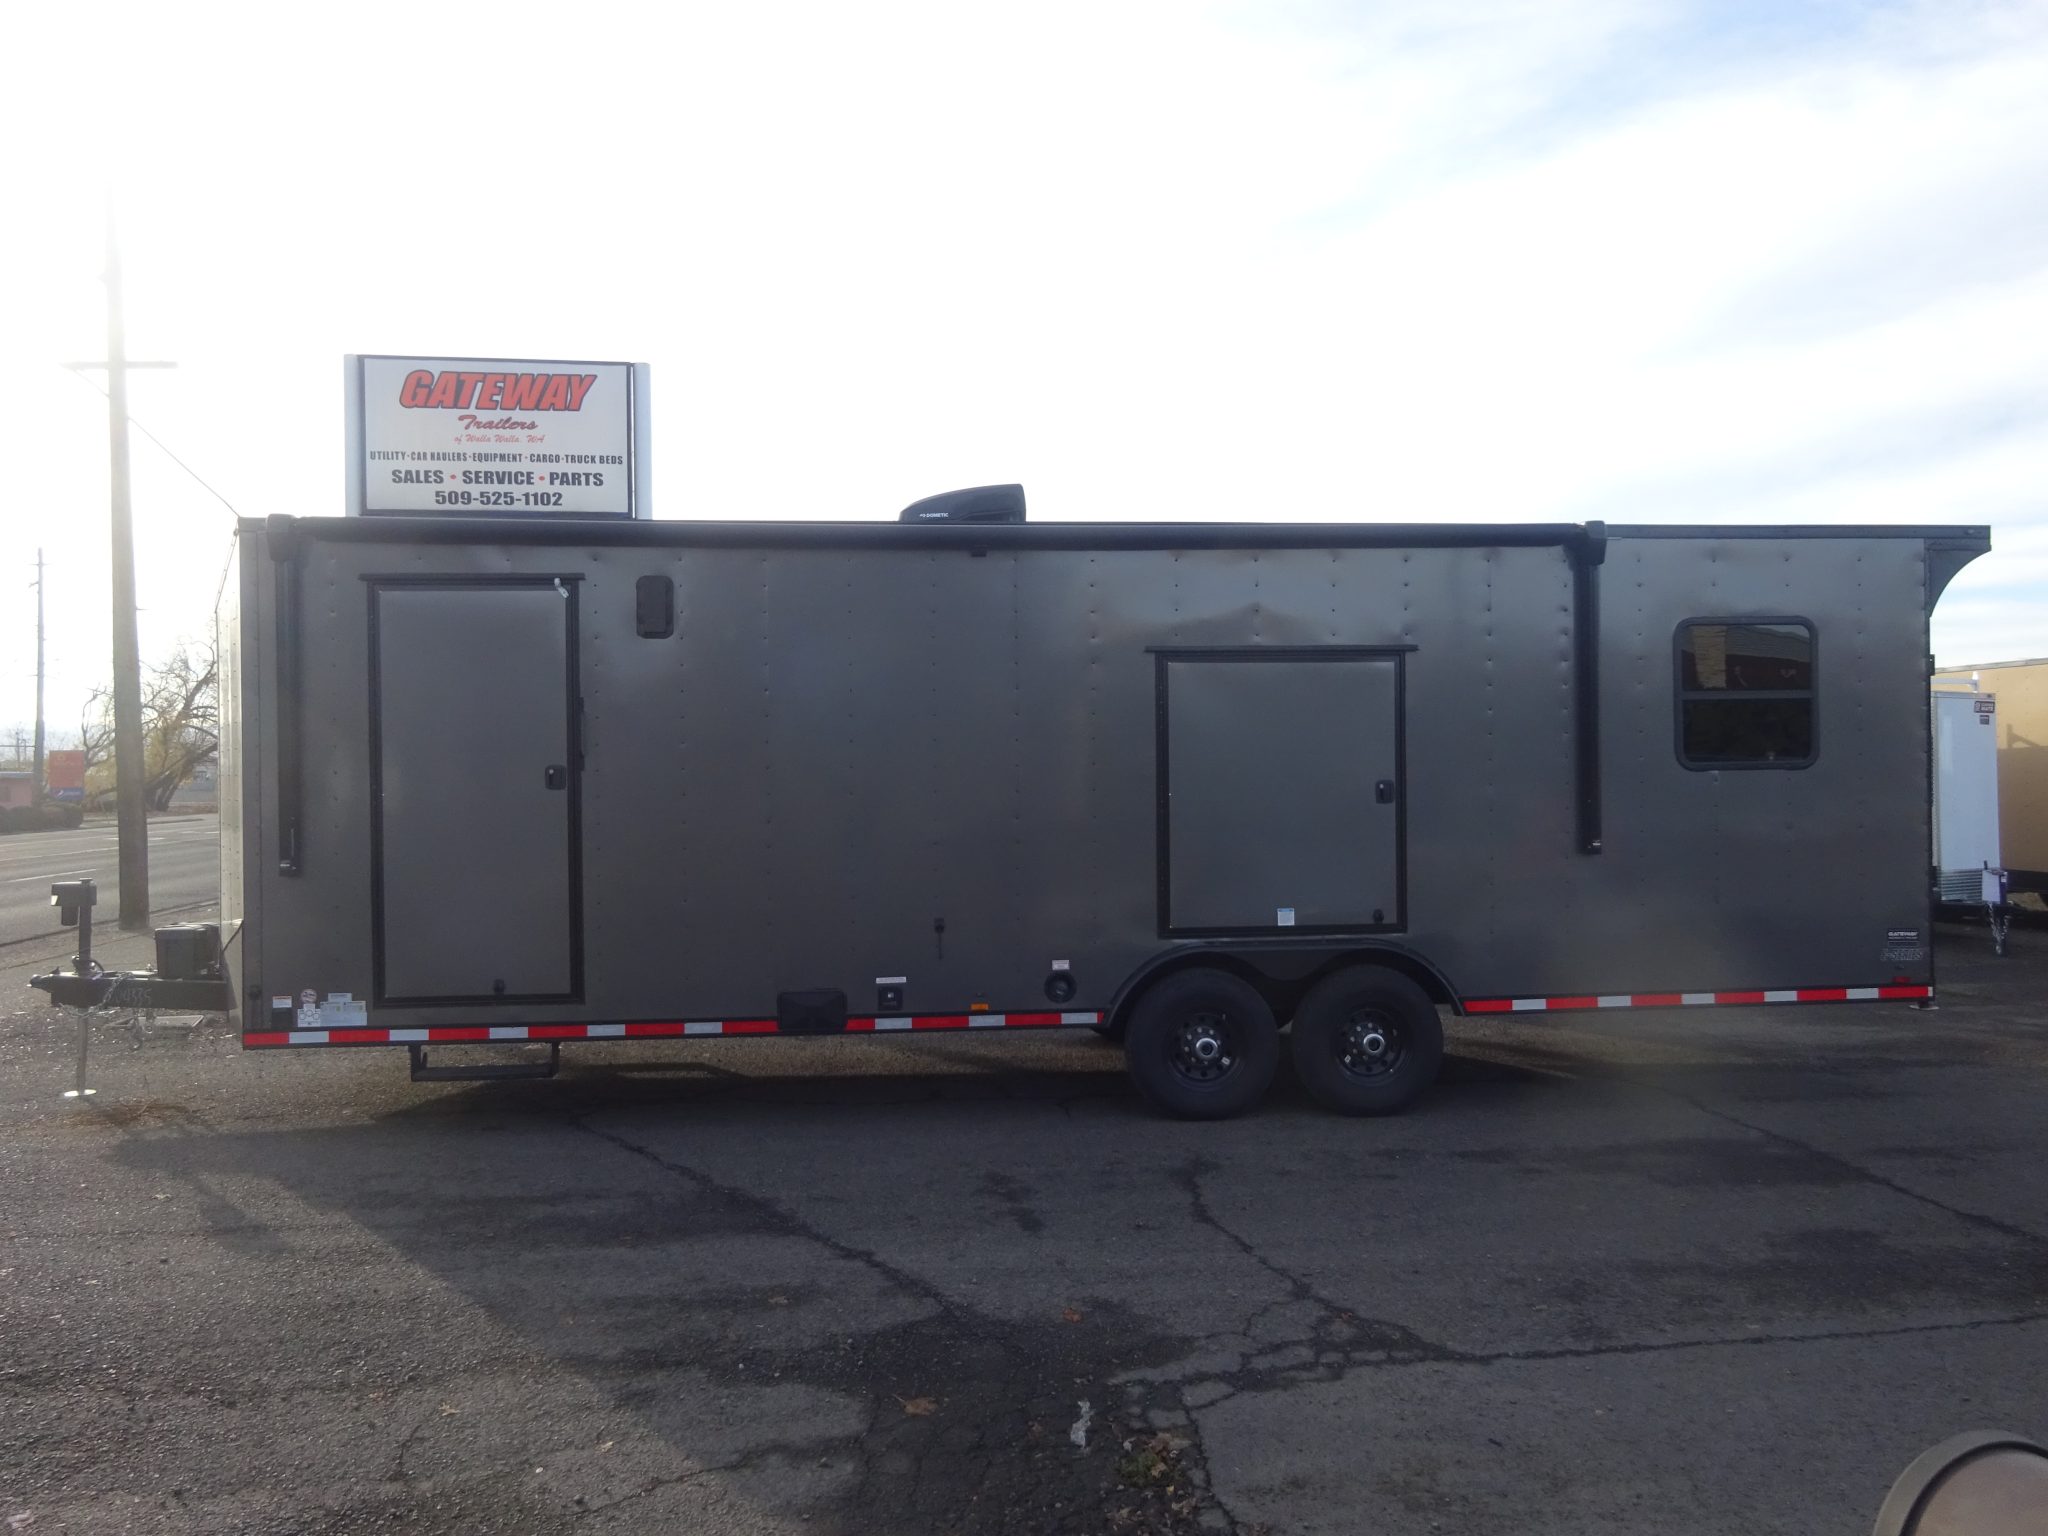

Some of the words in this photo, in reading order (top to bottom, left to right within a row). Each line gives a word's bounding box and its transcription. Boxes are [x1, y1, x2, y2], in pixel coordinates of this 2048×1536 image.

[399, 369, 597, 411] GATEWAY
[458, 414, 538, 430] Trailers
[454, 435, 463, 444] of
[466, 434, 491, 443] Walla
[526, 435, 546, 443] WA
[370, 450, 406, 461] UTILITY
[410, 451, 427, 461] CAR
[430, 452, 467, 462] HAULERS
[472, 452, 522, 463] EQUIPMENT
[529, 453, 560, 464] CARGO
[565, 454, 597, 465] TRUCK
[599, 455, 623, 465] BEDS
[391, 469, 444, 484] SALES
[462, 470, 534, 485] SERVICE
[549, 471, 604, 487] PARTS
[434, 490, 563, 506] 509-525-1102
